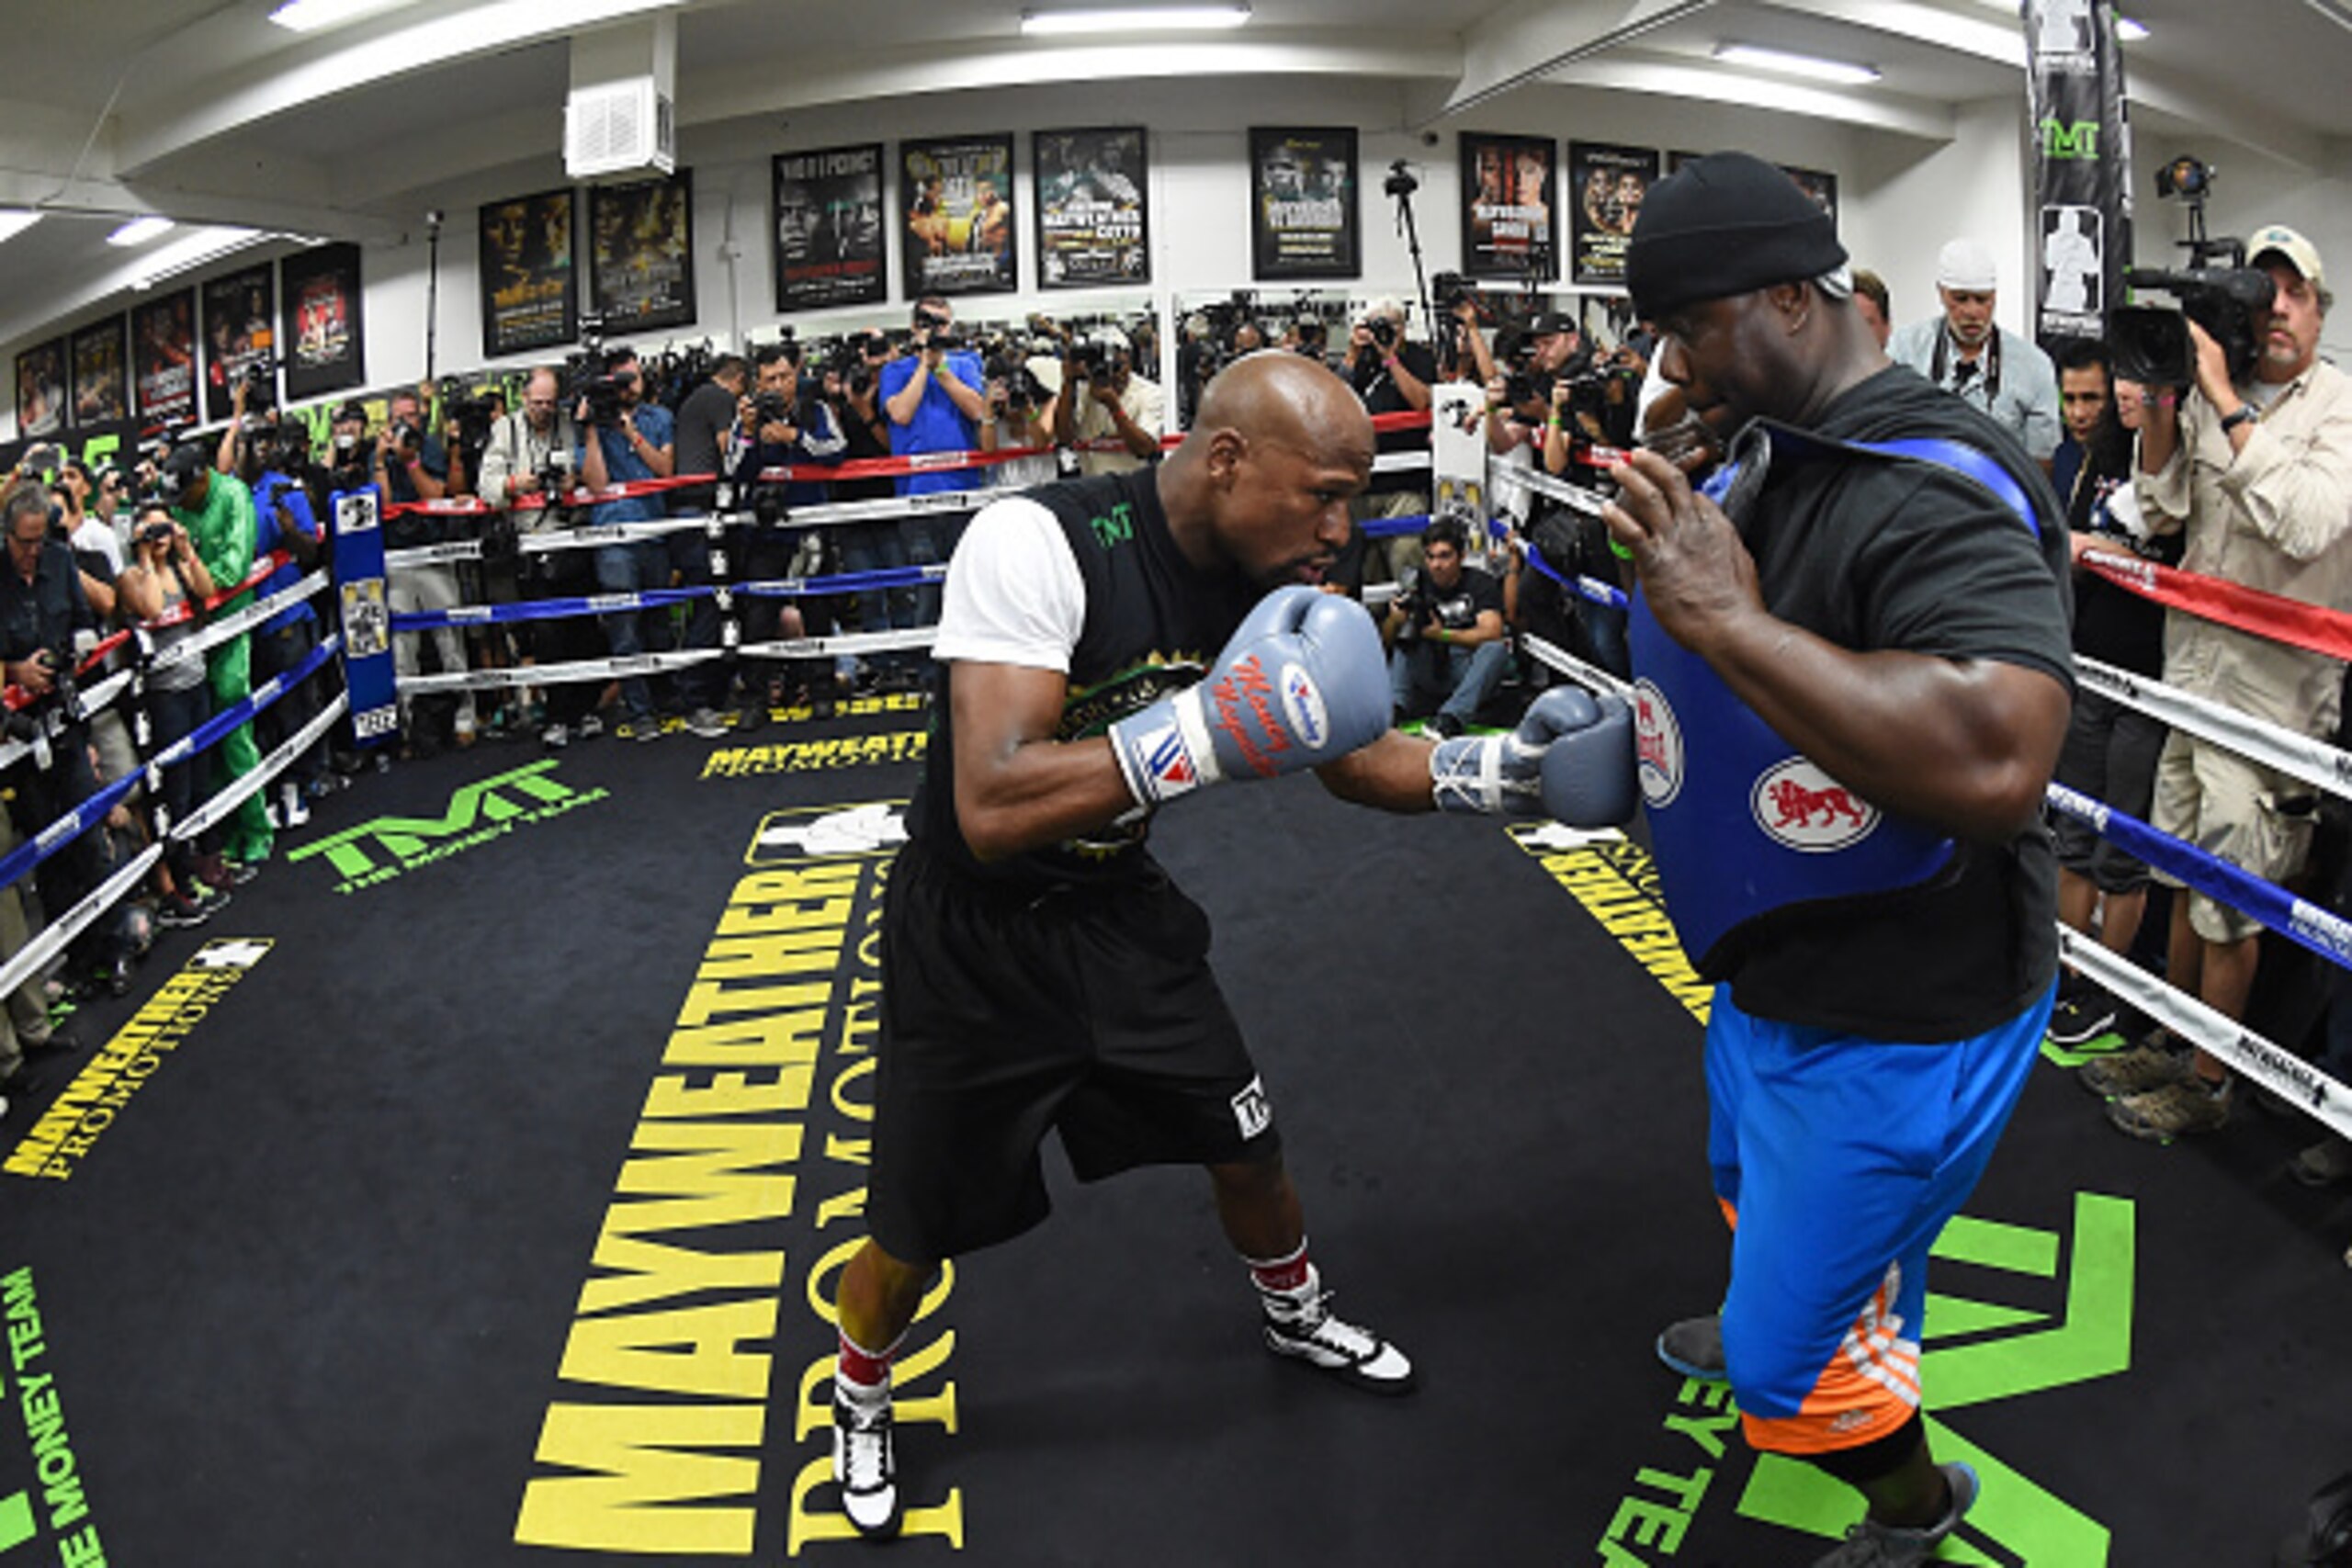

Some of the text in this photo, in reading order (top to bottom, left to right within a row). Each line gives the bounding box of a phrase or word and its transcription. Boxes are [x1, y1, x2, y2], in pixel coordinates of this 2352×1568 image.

[2039, 118, 2100, 160] TMT
[286, 759, 574, 879] TMT
[2, 971, 213, 1178] MAYWEATHER
[39, 968, 243, 1181] PROMOTIONS
[514, 863, 862, 1555] MAYWEATHER
[0, 1265, 47, 1371] TEAM
[17, 1372, 90, 1529] MONEY
